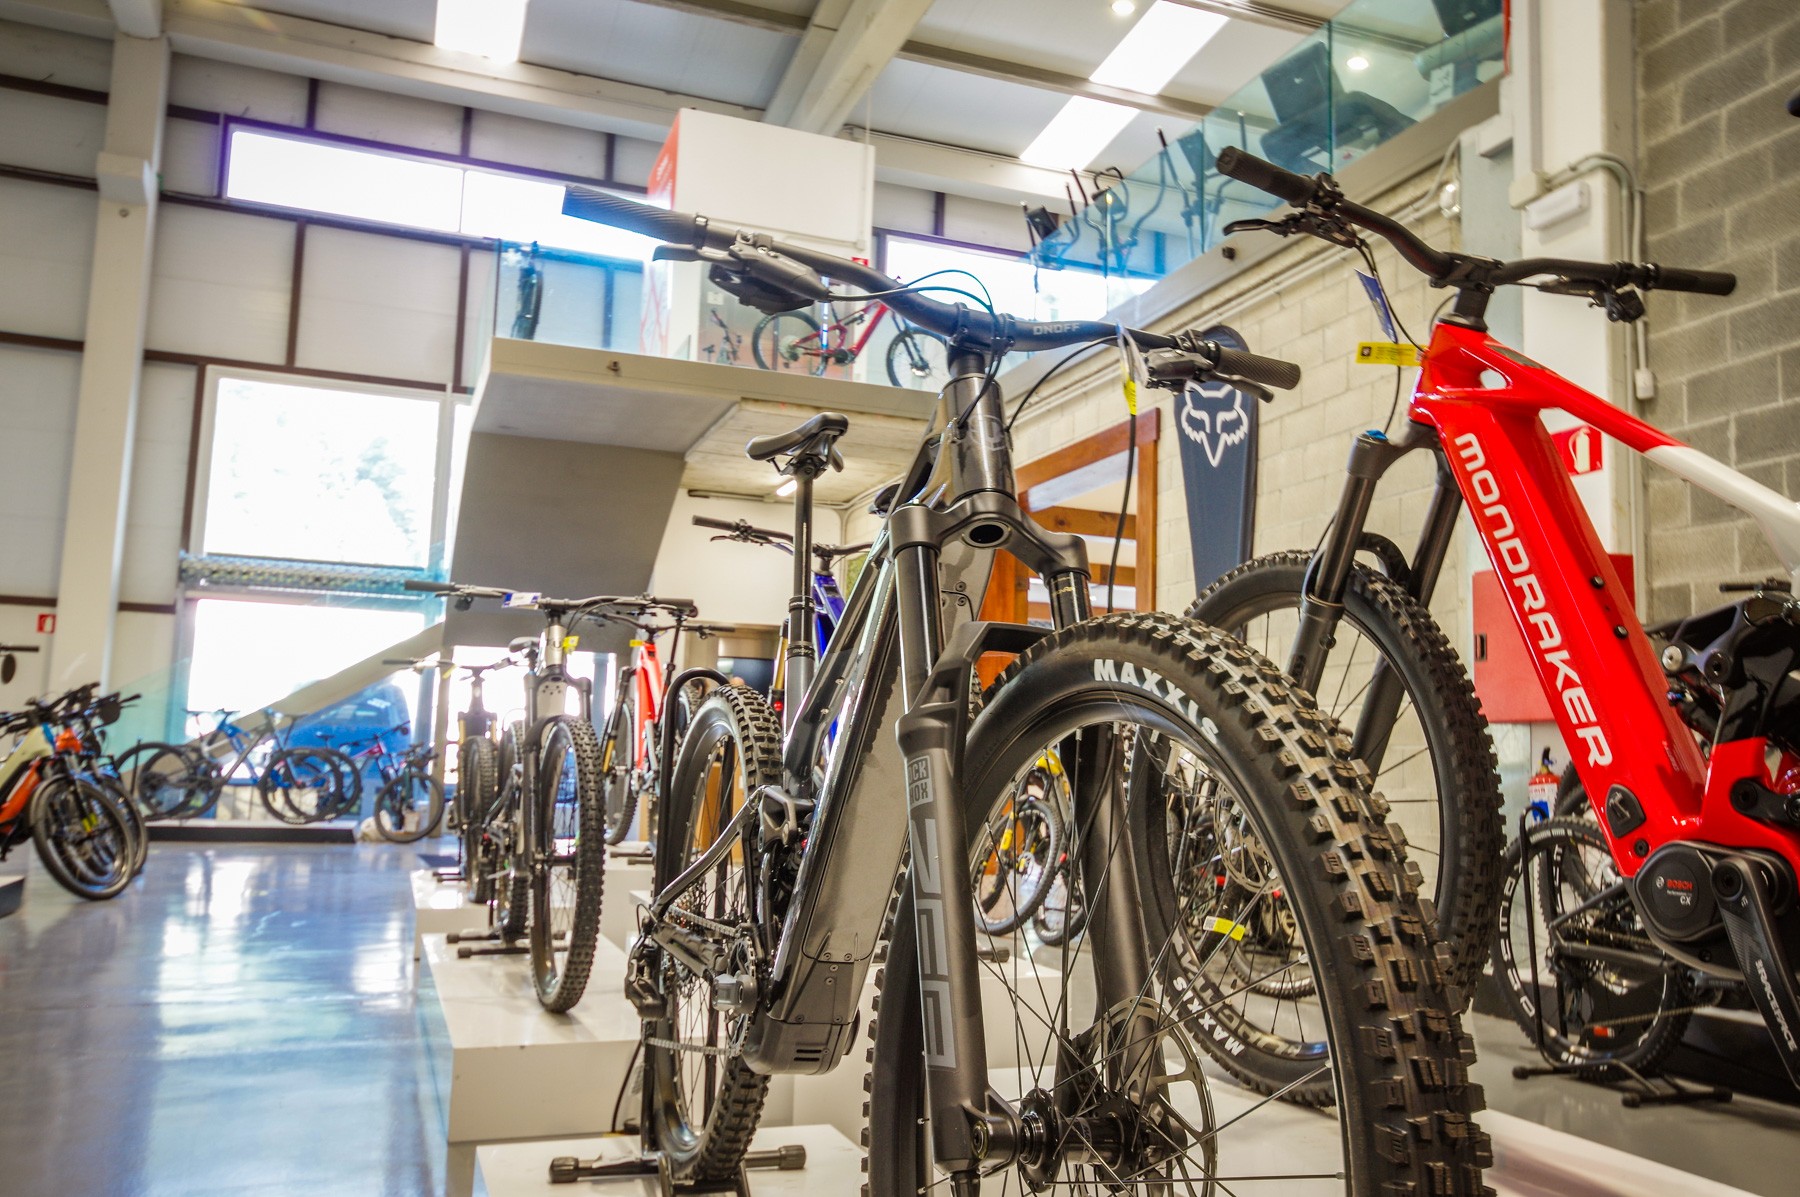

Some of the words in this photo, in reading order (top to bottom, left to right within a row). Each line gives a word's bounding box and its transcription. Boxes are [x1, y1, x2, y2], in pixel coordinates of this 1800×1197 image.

[1454, 431, 1613, 769] MONDRAKER
[1094, 658, 1219, 745] MAXXIS
[1667, 879, 1693, 890] BOSCH
[1680, 895, 1691, 906] CX
[1172, 976, 1246, 1057] MAXXIS
